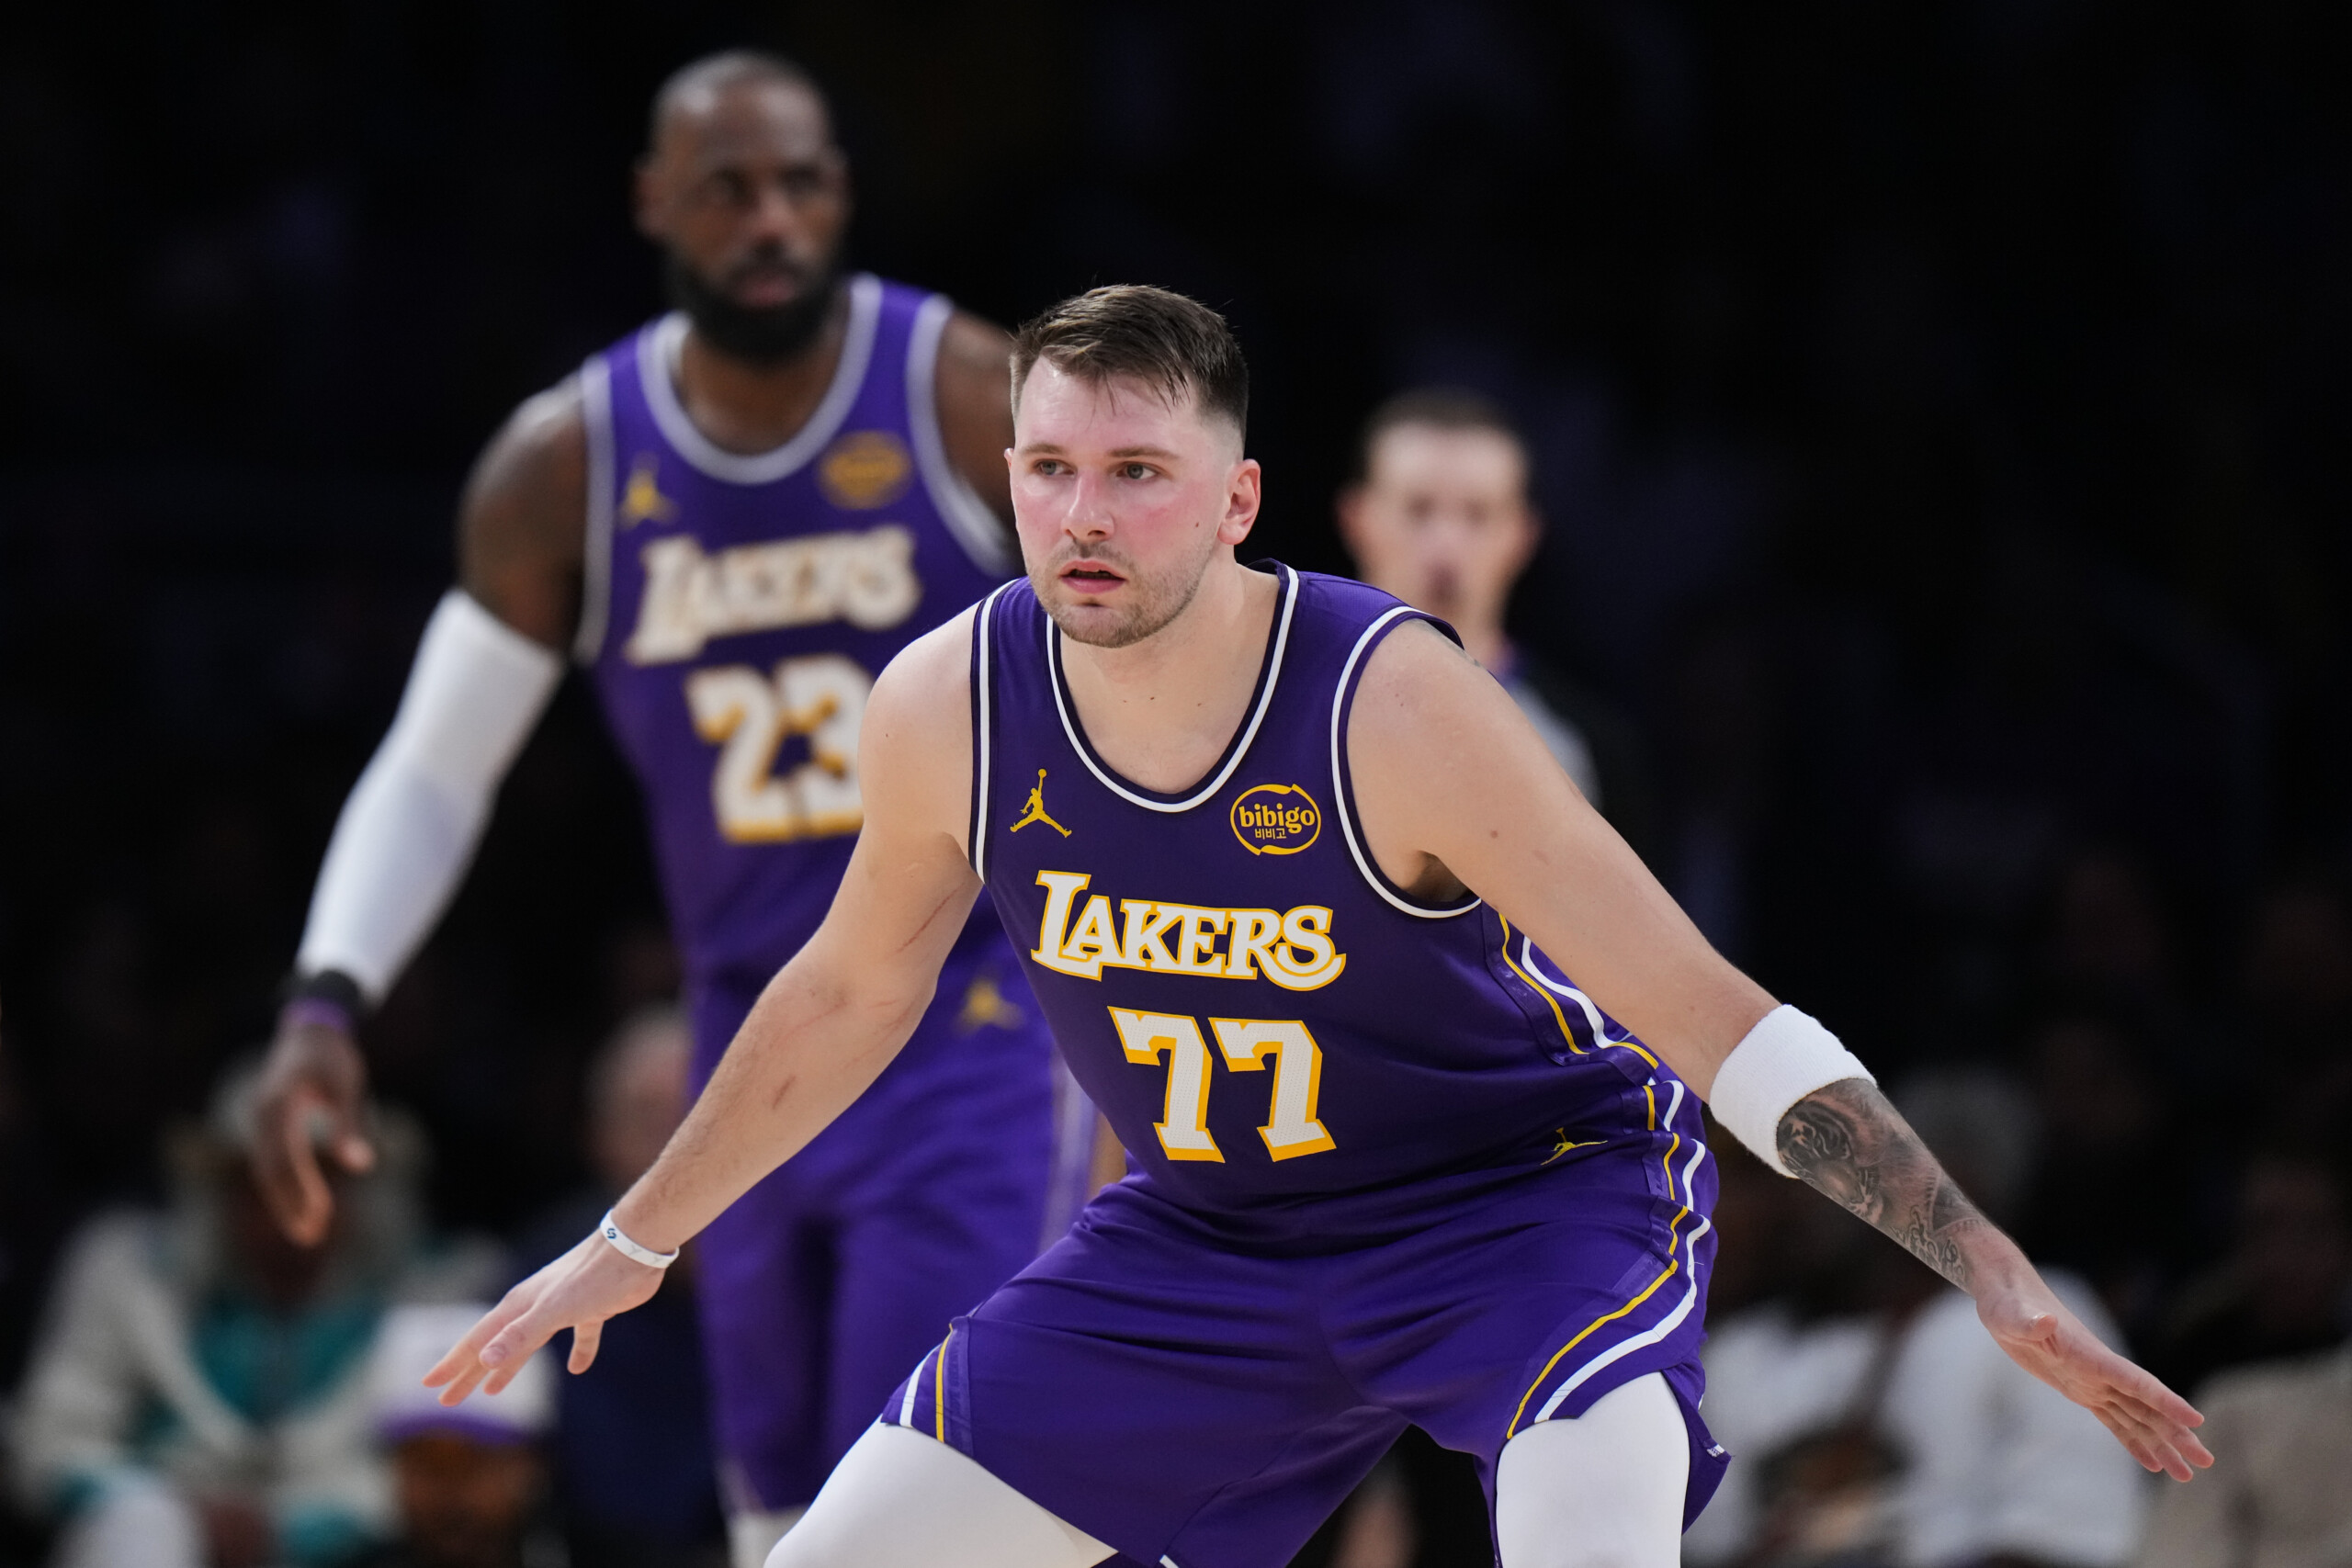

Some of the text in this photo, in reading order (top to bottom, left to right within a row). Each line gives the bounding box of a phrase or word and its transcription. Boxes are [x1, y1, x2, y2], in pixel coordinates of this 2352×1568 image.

[686, 653, 875, 841] 23
[1238, 803, 1316, 834] bibigo
[1254, 828, 1287, 840] 비비고
[1031, 870, 1347, 991] LAKERS
[1107, 1006, 1338, 1164] 77
